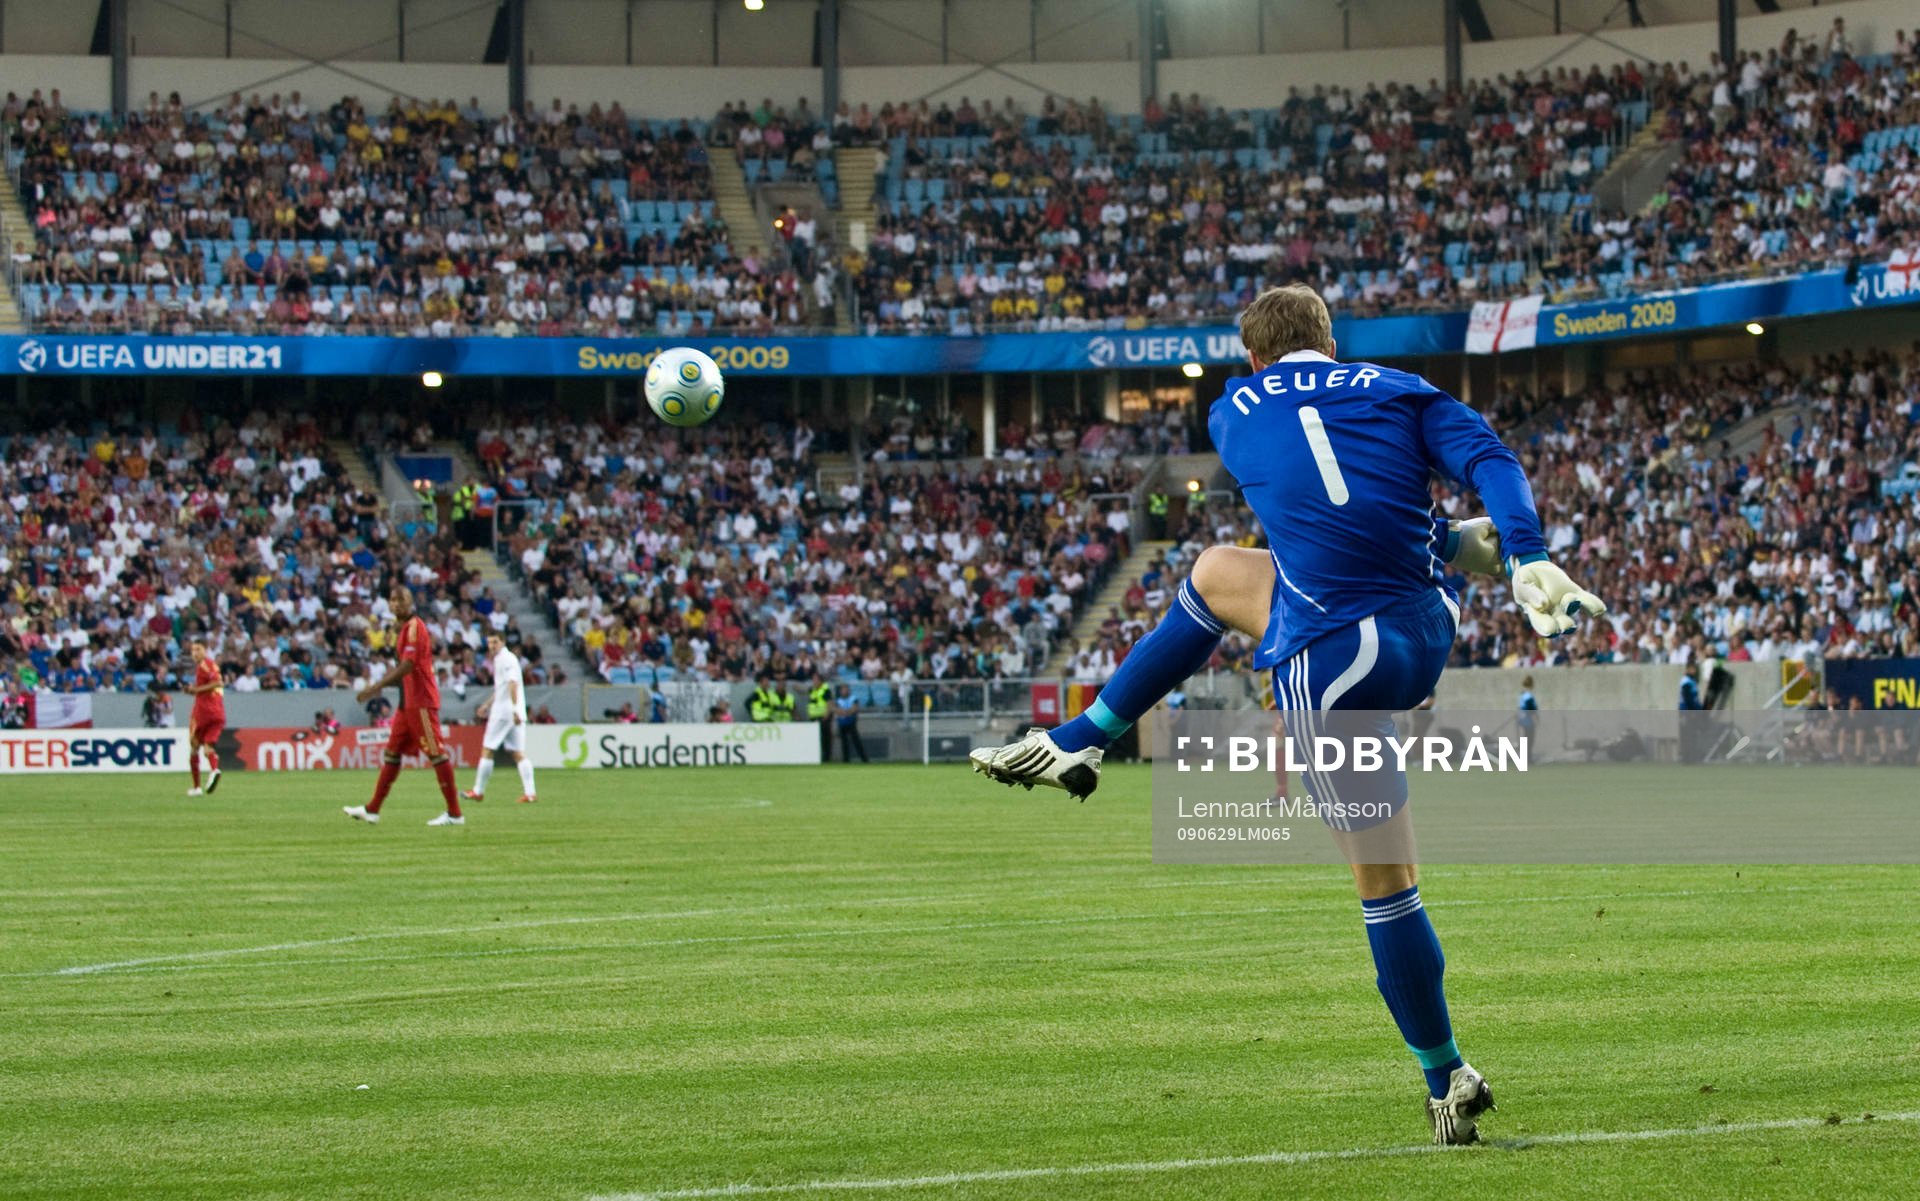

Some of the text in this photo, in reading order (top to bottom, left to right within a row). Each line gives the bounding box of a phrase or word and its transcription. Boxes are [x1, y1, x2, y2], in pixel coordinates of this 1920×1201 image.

[1554, 311, 1627, 338] Sweden
[1631, 301, 1676, 328] 2009
[57, 345, 282, 369] UEFA UNDER21
[711, 345, 789, 369] 2009
[1124, 336, 1199, 361] UEFA
[1232, 368, 1381, 416] NEUER
[1298, 405, 1350, 506] 1
[1874, 677, 1920, 709] FIN
[1, 738, 176, 768] TERSPORT
[600, 734, 747, 767] Studentis
